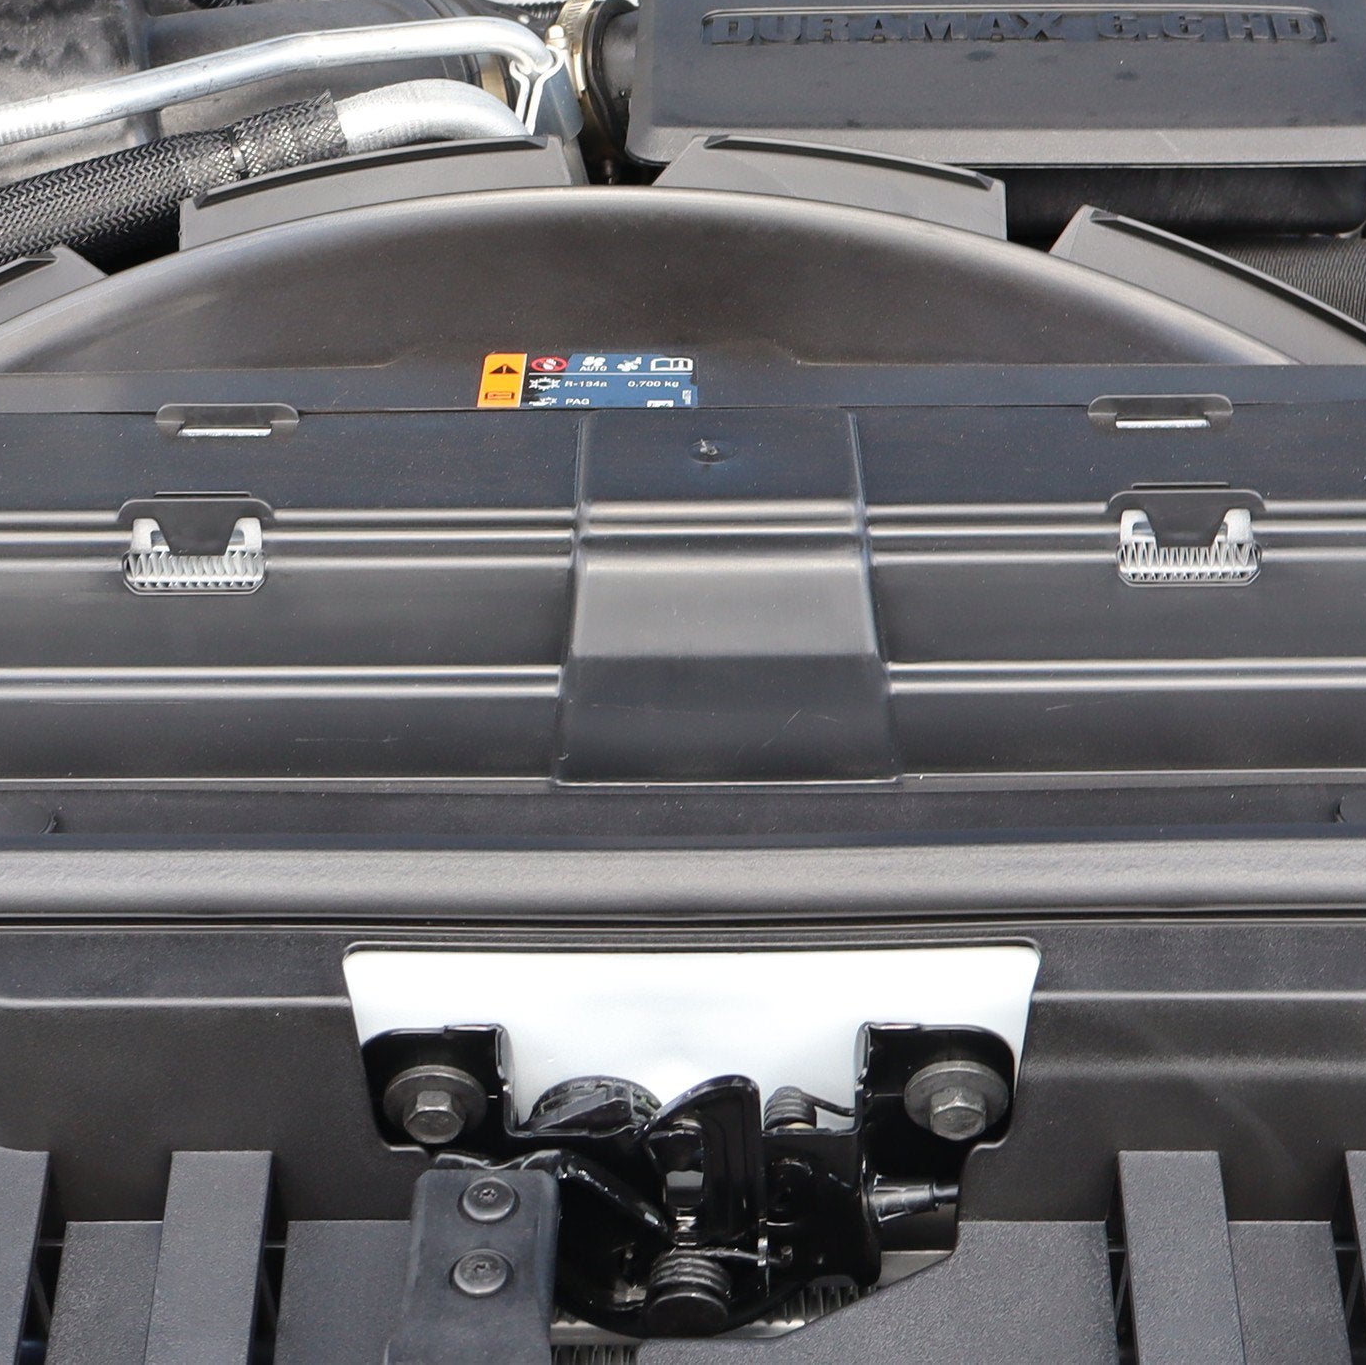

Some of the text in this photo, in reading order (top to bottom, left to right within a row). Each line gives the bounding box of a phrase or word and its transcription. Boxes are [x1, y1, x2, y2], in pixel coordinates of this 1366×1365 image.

[710, 12, 1322, 45] DURAMAX 6.6 HD
[564, 380, 608, 388] R-134a
[627, 380, 662, 388] 0.700
